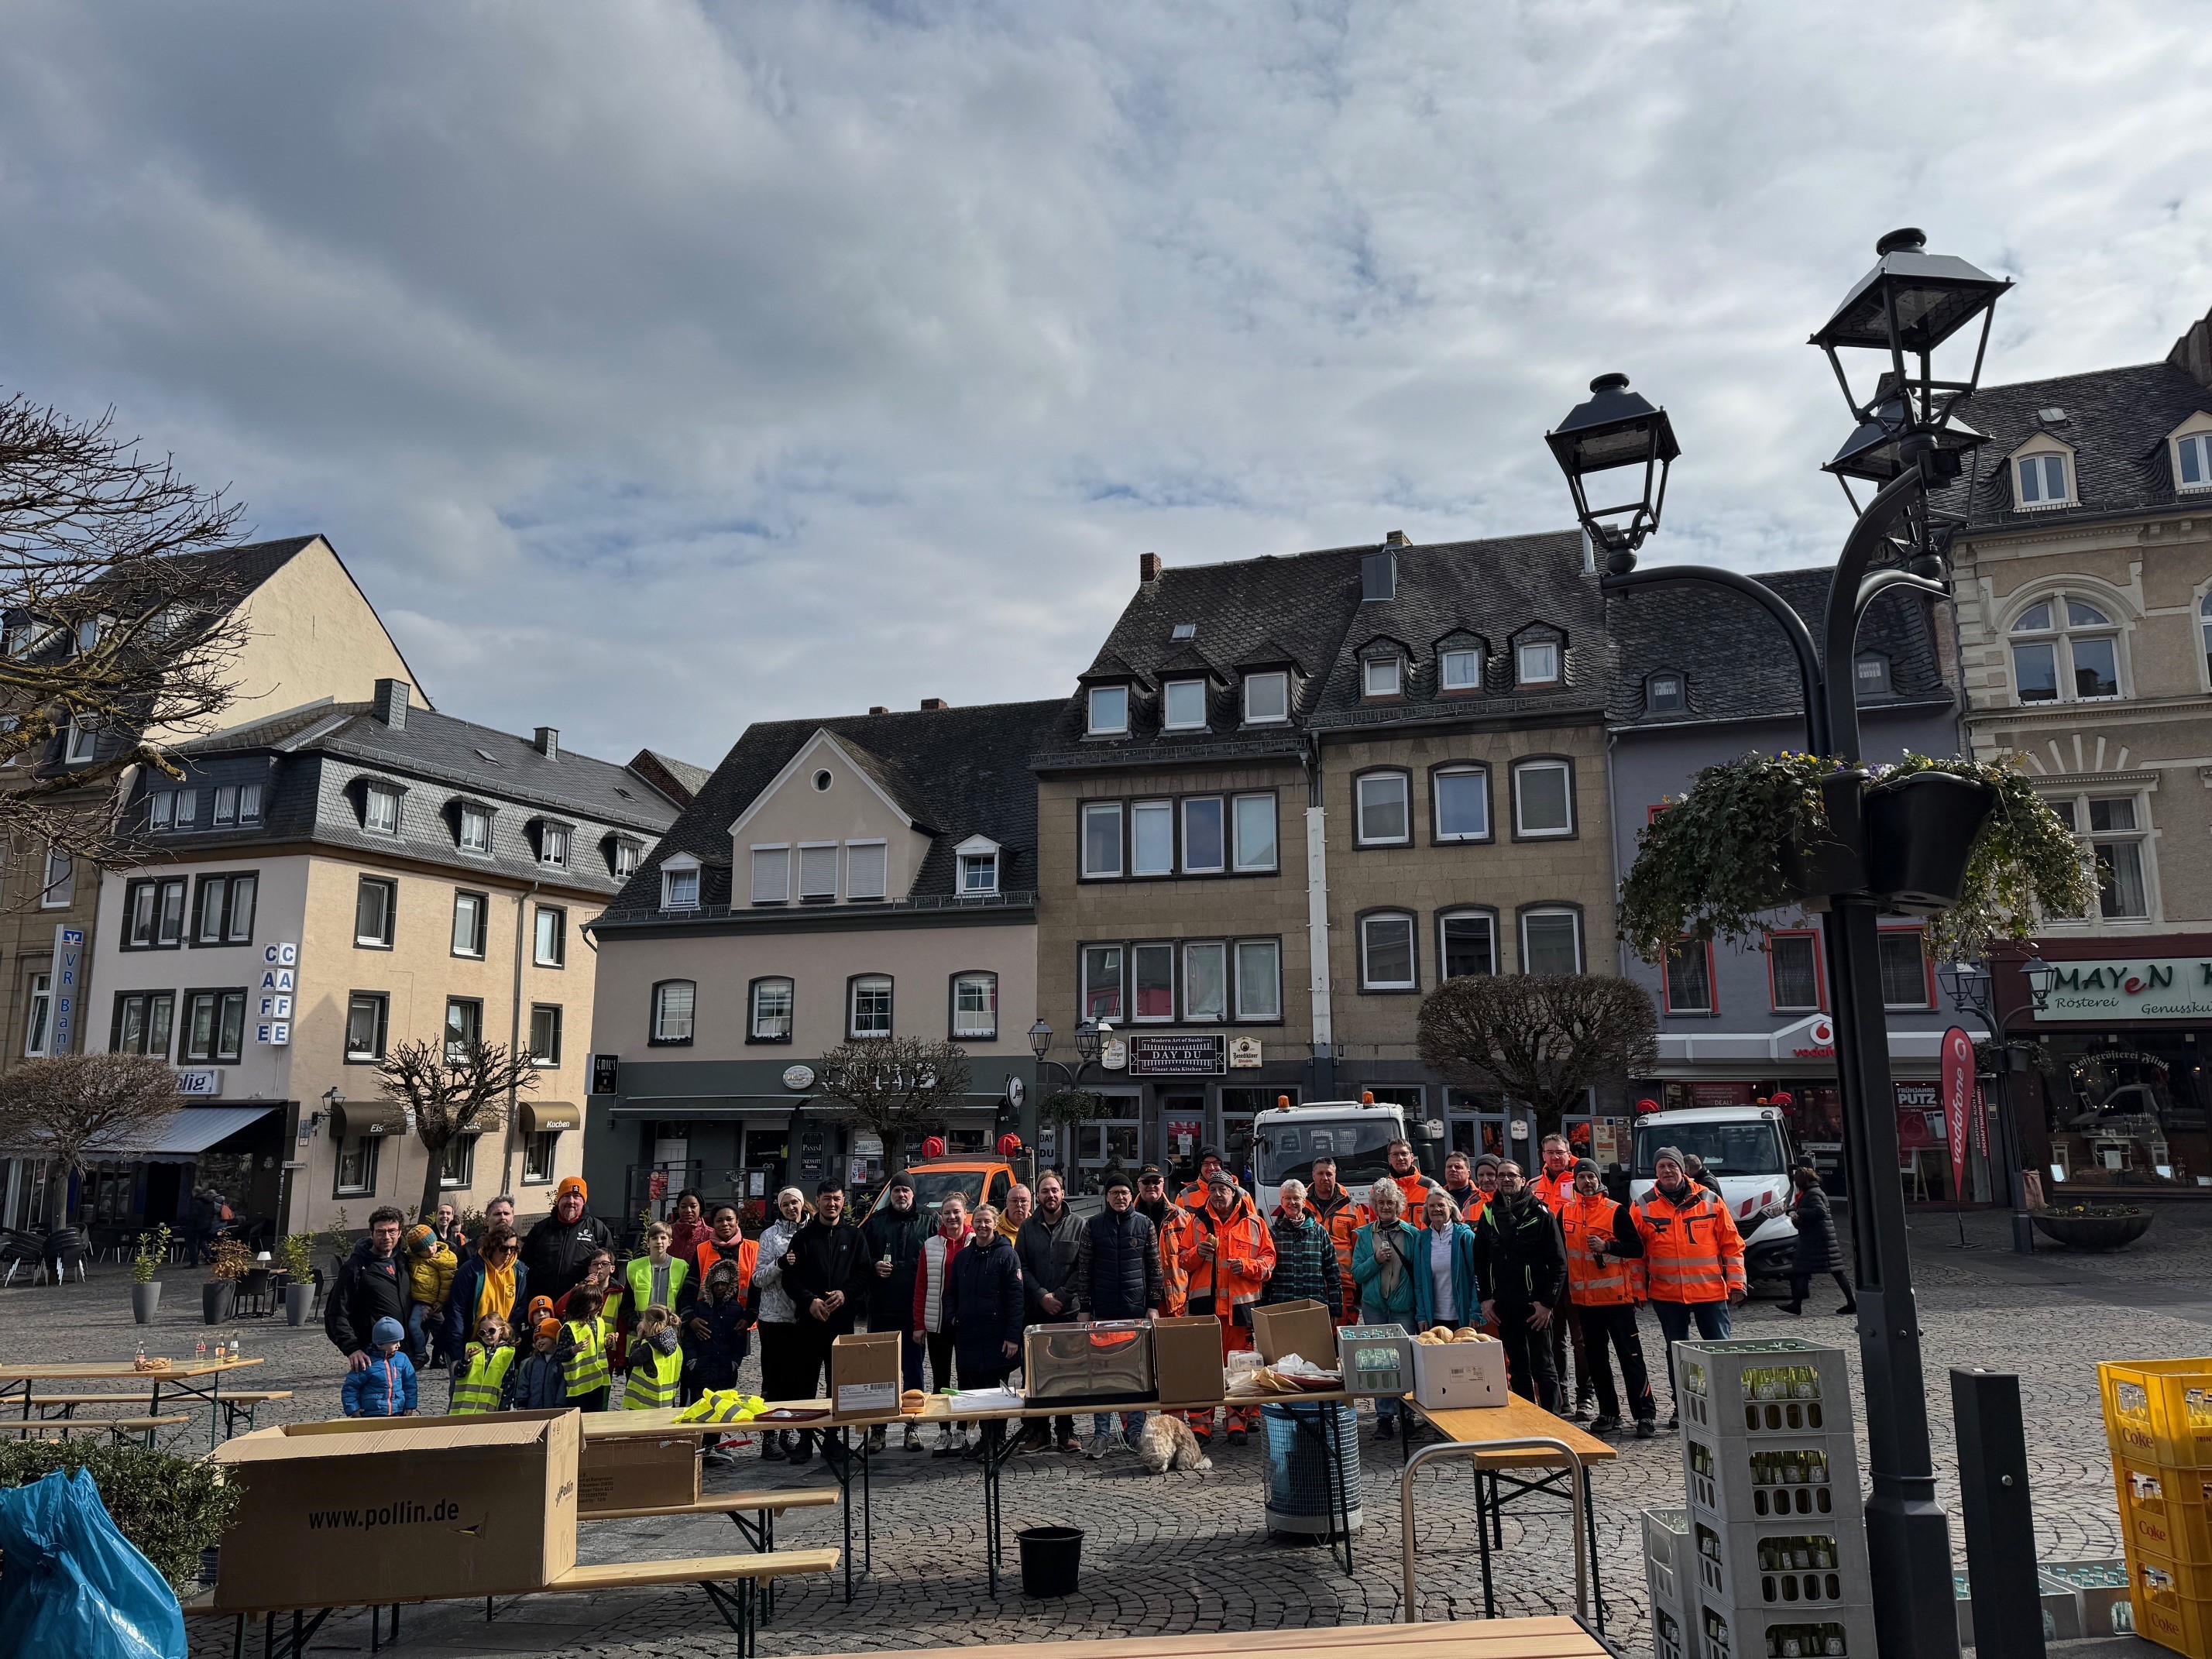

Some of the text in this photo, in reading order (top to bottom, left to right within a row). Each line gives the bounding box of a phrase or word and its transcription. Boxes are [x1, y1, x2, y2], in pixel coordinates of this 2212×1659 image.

[2055, 997, 2119, 1008] Rösterei
[2142, 1001, 2212, 1014] Genussku
[1152, 1050, 1201, 1060] DAY DU
[2141, 1053, 2170, 1071] Flink
[1898, 1093, 1938, 1104] PUTZ
[1952, 1067, 1964, 1163] vodafone
[370, 1124, 383, 1132] Eis
[1039, 1134, 1054, 1142] DAY
[1039, 1149, 1054, 1157] DU
[2122, 1427, 2154, 1449] Coke
[309, 1498, 459, 1531] www.pollin.de
[2138, 1520, 2166, 1541] Coke
[2152, 1613, 2179, 1636] Coke
